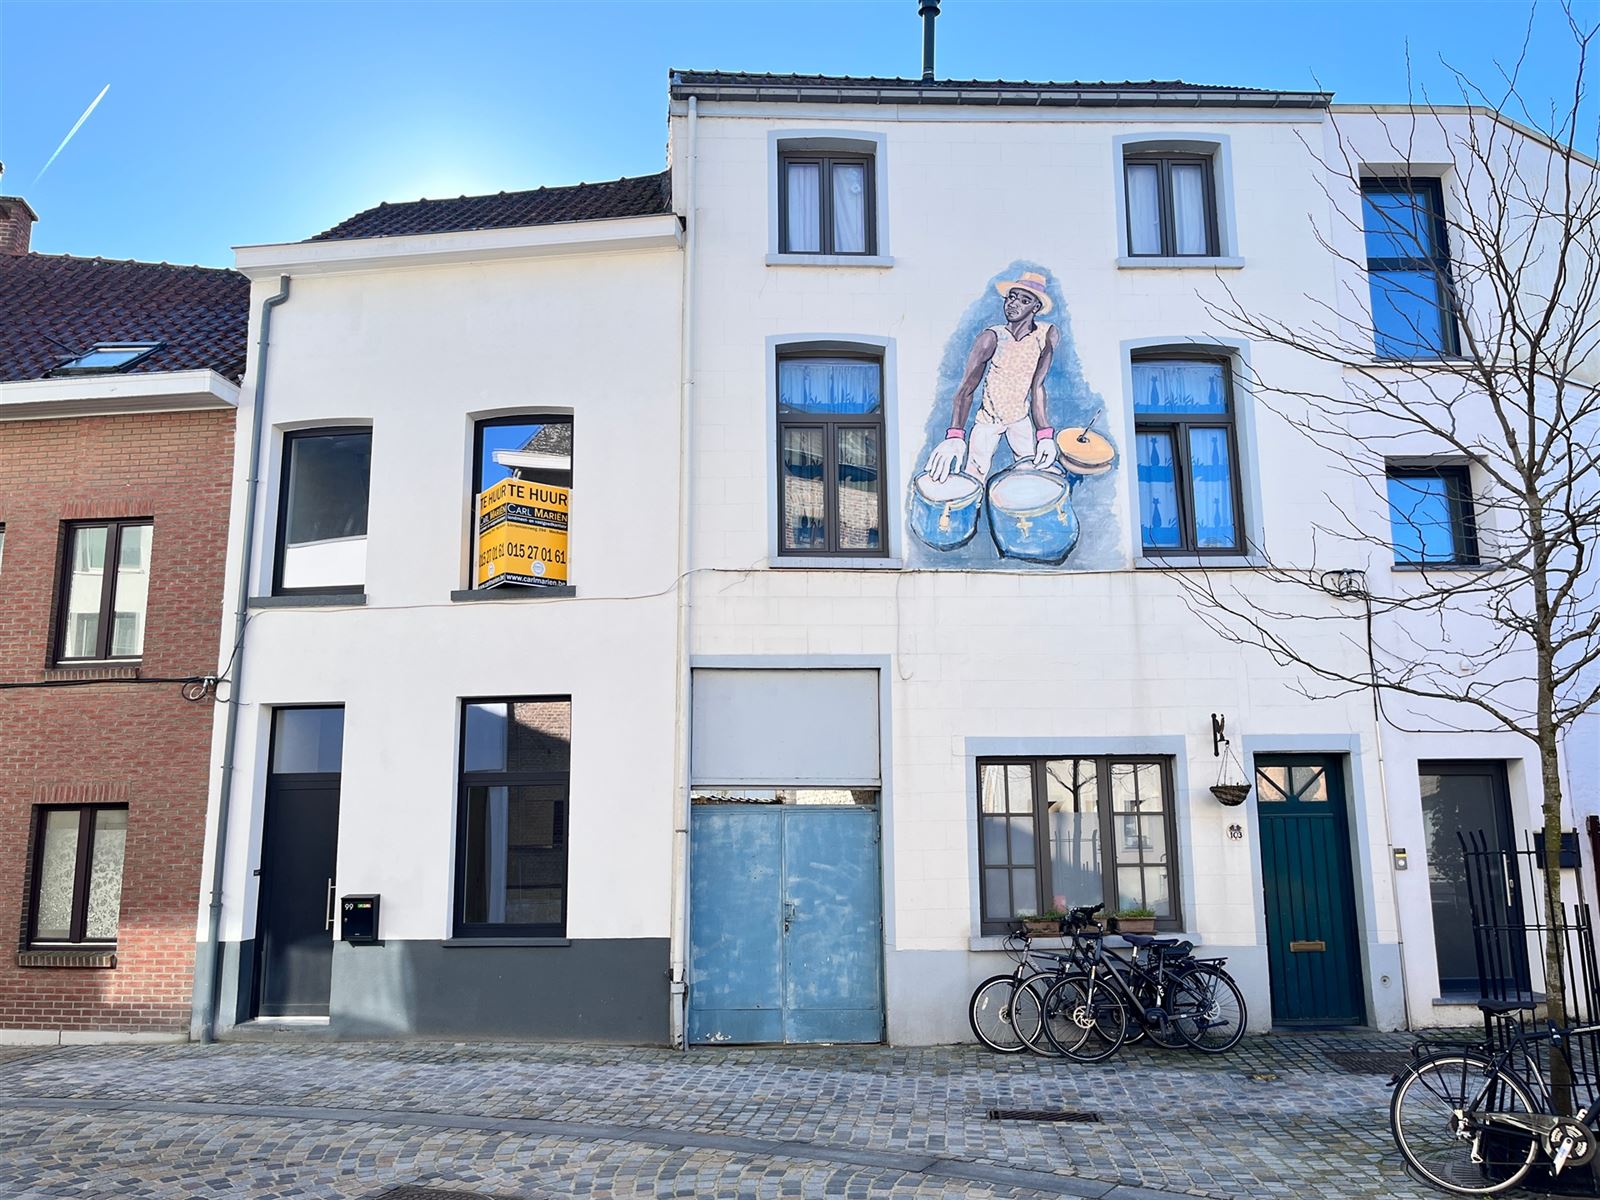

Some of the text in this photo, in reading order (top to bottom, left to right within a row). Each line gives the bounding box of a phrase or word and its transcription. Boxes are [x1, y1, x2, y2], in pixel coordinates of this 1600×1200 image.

[508, 484, 568, 507] TE HUUR
[507, 503, 532, 516] CARL
[507, 542, 566, 564] 015 27 01 61
[506, 574, 566, 587] www.carlmarien.be
[1231, 831, 1243, 839] 103
